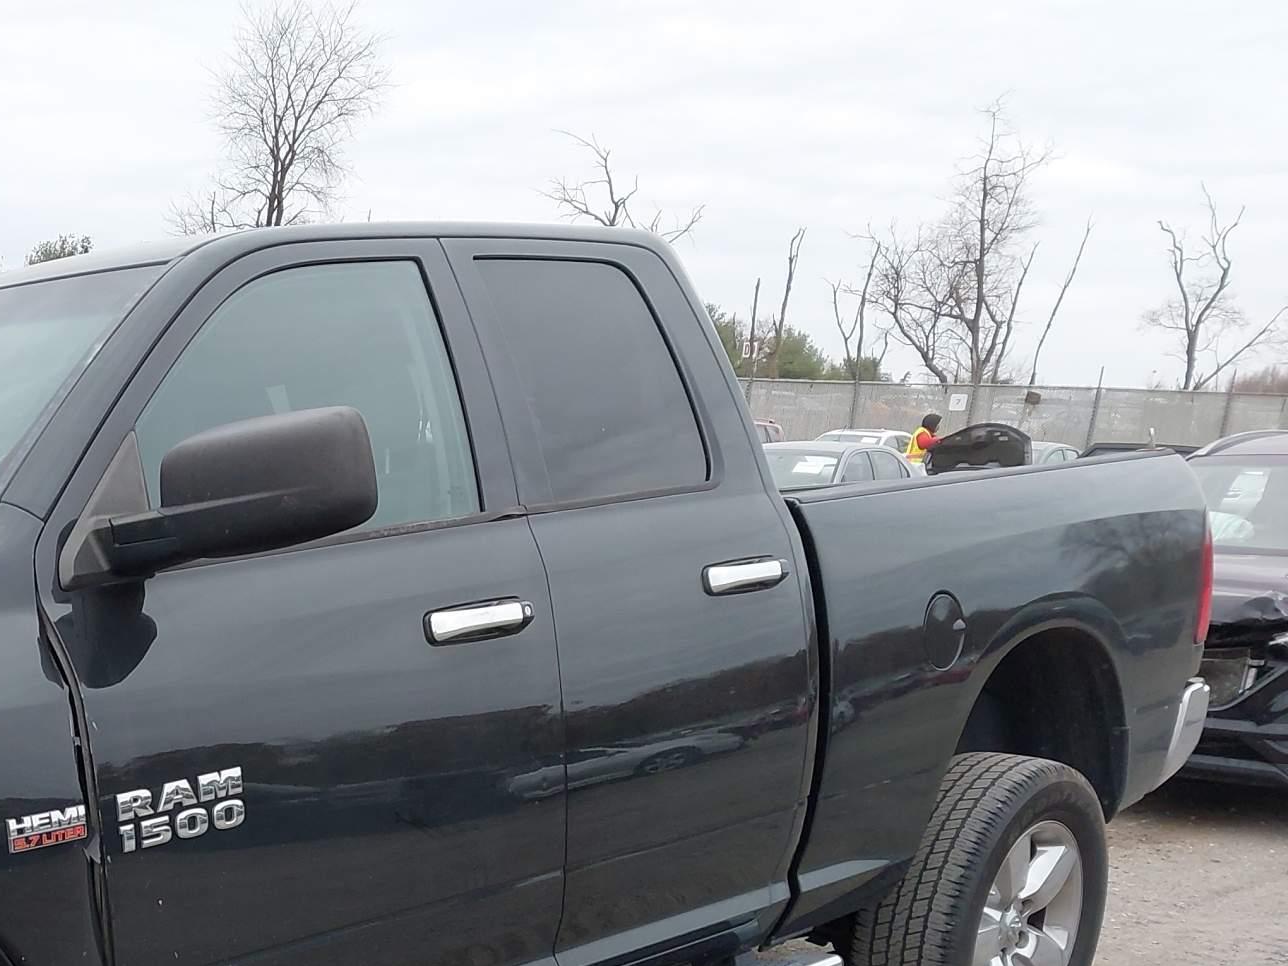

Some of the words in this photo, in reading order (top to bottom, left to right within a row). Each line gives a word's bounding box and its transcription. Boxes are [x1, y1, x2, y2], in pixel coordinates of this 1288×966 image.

[115, 766, 243, 822] RAM
[7, 804, 86, 836] HEMI
[13, 834, 40, 850] 5.7
[41, 825, 86, 845] LITER
[118, 799, 245, 853] 1500
